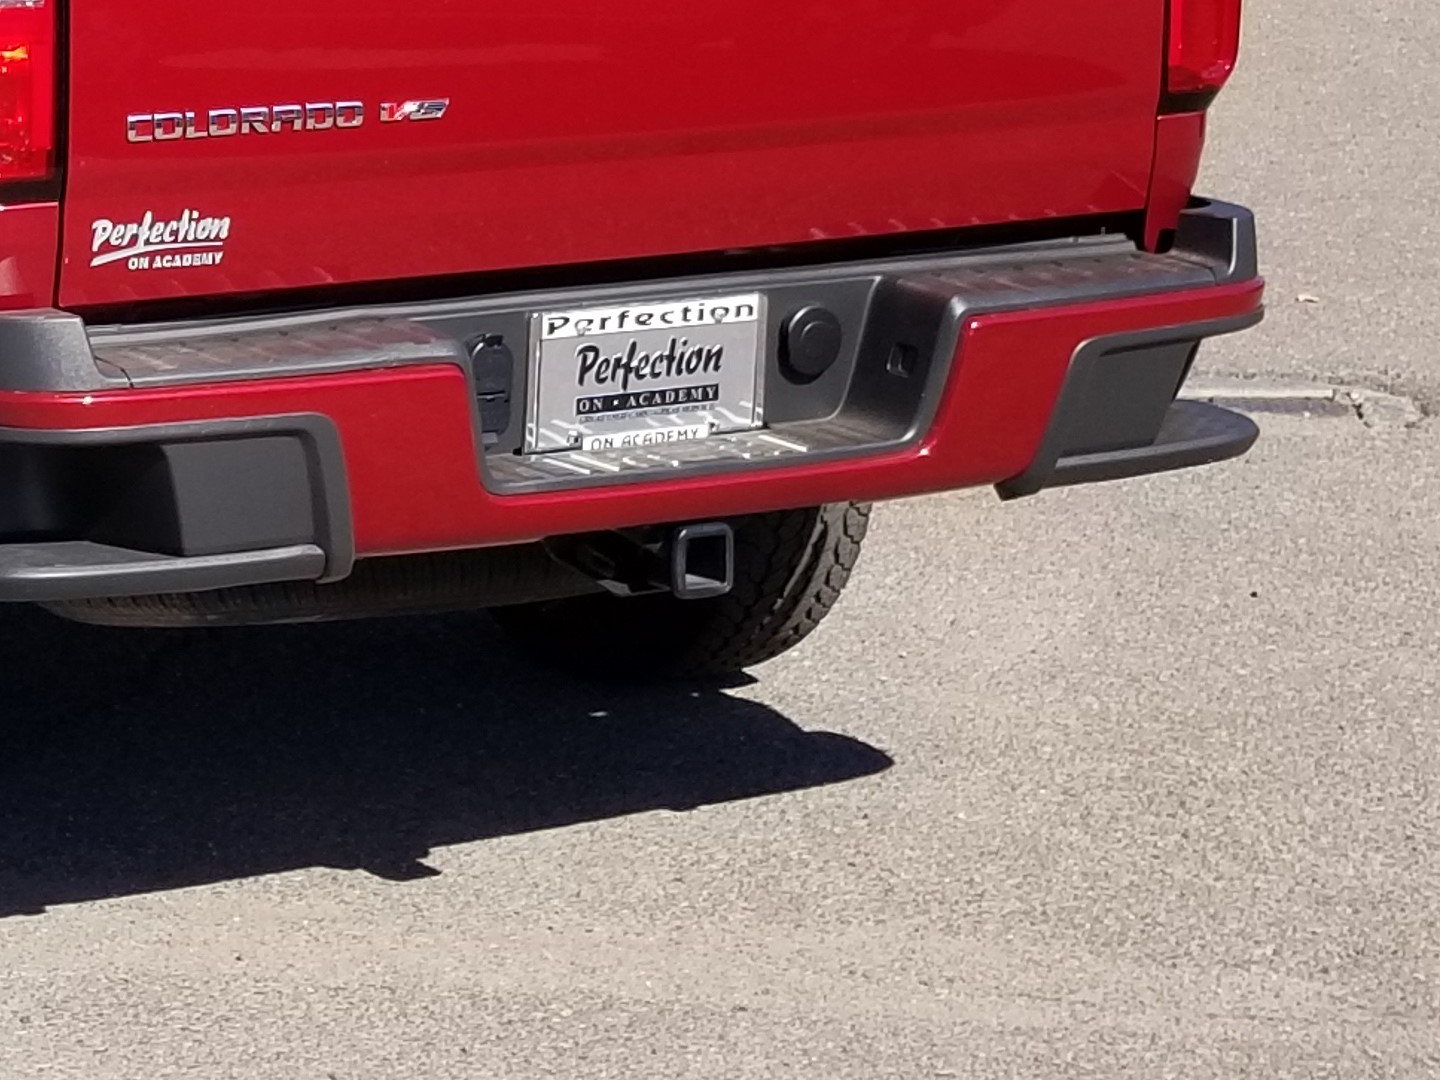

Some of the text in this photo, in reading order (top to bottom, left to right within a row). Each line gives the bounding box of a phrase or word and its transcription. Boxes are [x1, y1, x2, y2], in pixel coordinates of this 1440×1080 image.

[126, 100, 364, 143] COLORADO
[91, 208, 231, 253] Perfection
[127, 251, 224, 270] ON ACADEMY
[546, 303, 755, 335] Perfection
[575, 337, 724, 391] Perfection
[578, 385, 717, 413] ON ACADEMY
[590, 428, 699, 451] ON ACADEMY
